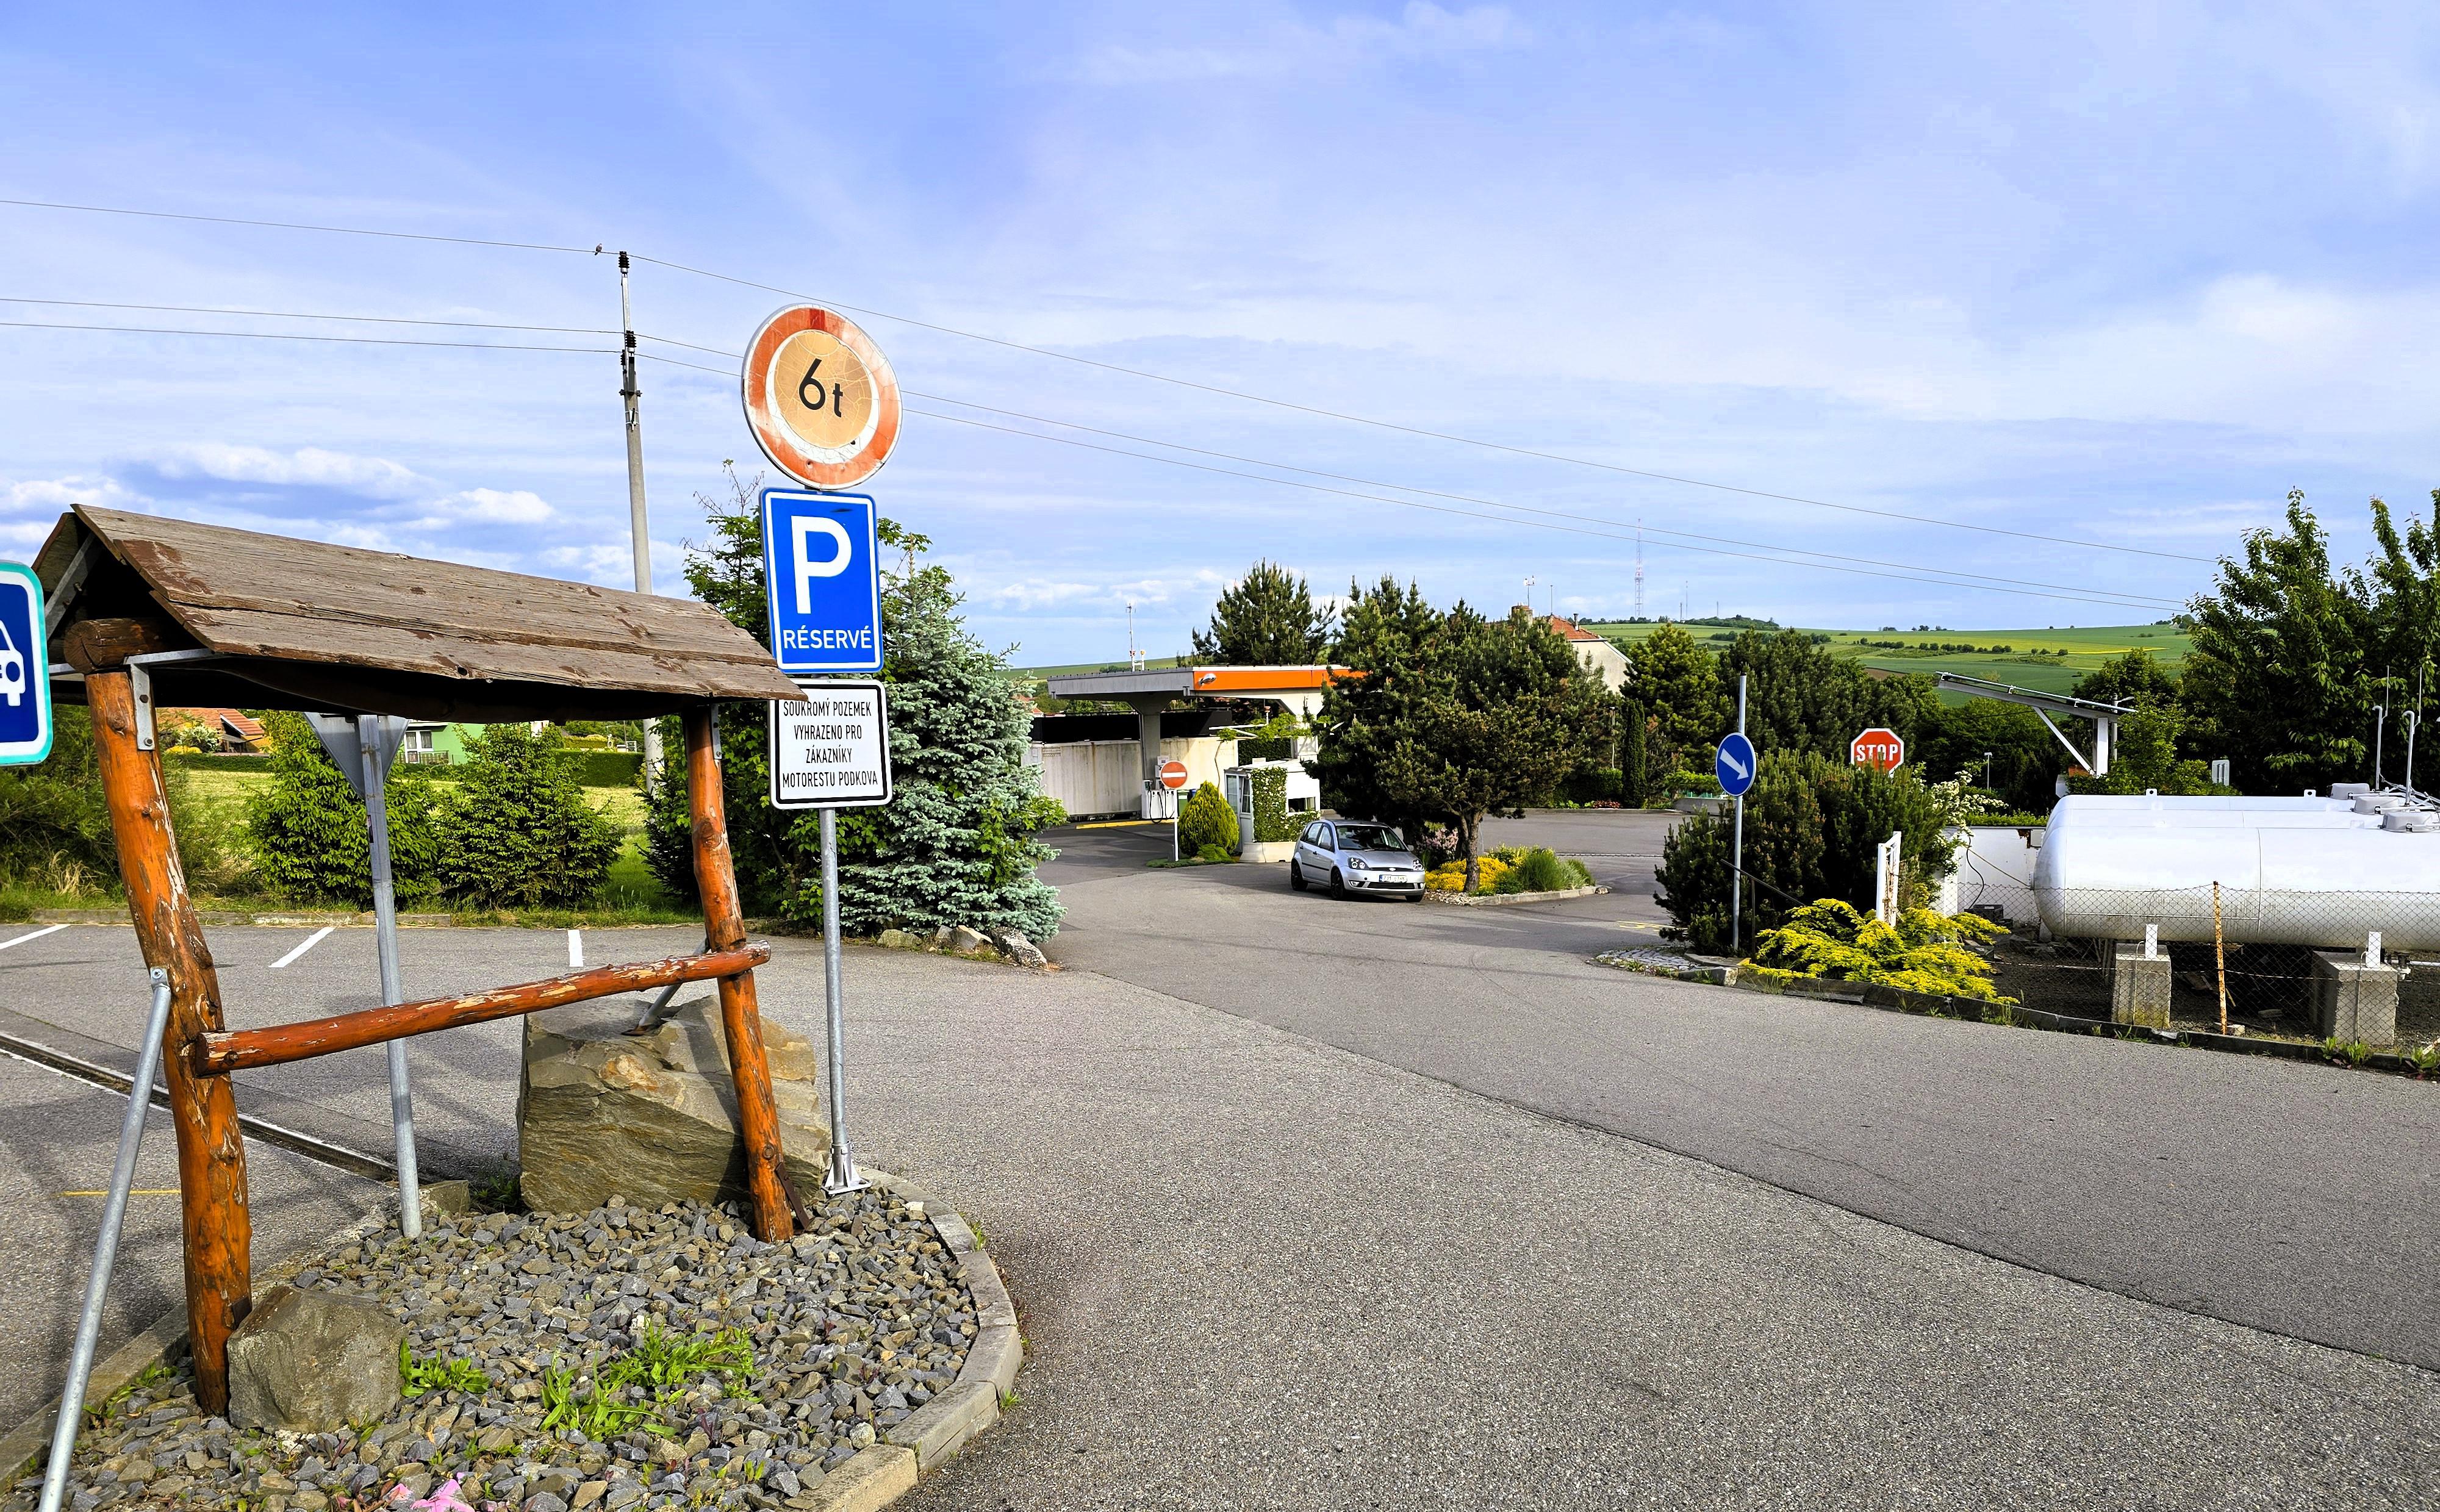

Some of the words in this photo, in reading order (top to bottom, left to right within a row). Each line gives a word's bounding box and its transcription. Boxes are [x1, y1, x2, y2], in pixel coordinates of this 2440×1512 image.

[791, 515, 852, 614] P
[783, 625, 872, 650] RÉSERVÉ
[783, 698, 830, 717] SOUKROMÝ
[833, 701, 872, 717] POZEMEK
[794, 725, 842, 740] VYHRAZENO
[846, 725, 862, 739] PRO
[806, 745, 852, 764] ZÁKAZNÍKY
[1856, 743, 1898, 762] STOP
[783, 772, 835, 788] MOTORESTU
[839, 770, 878, 786] PODKOVA
